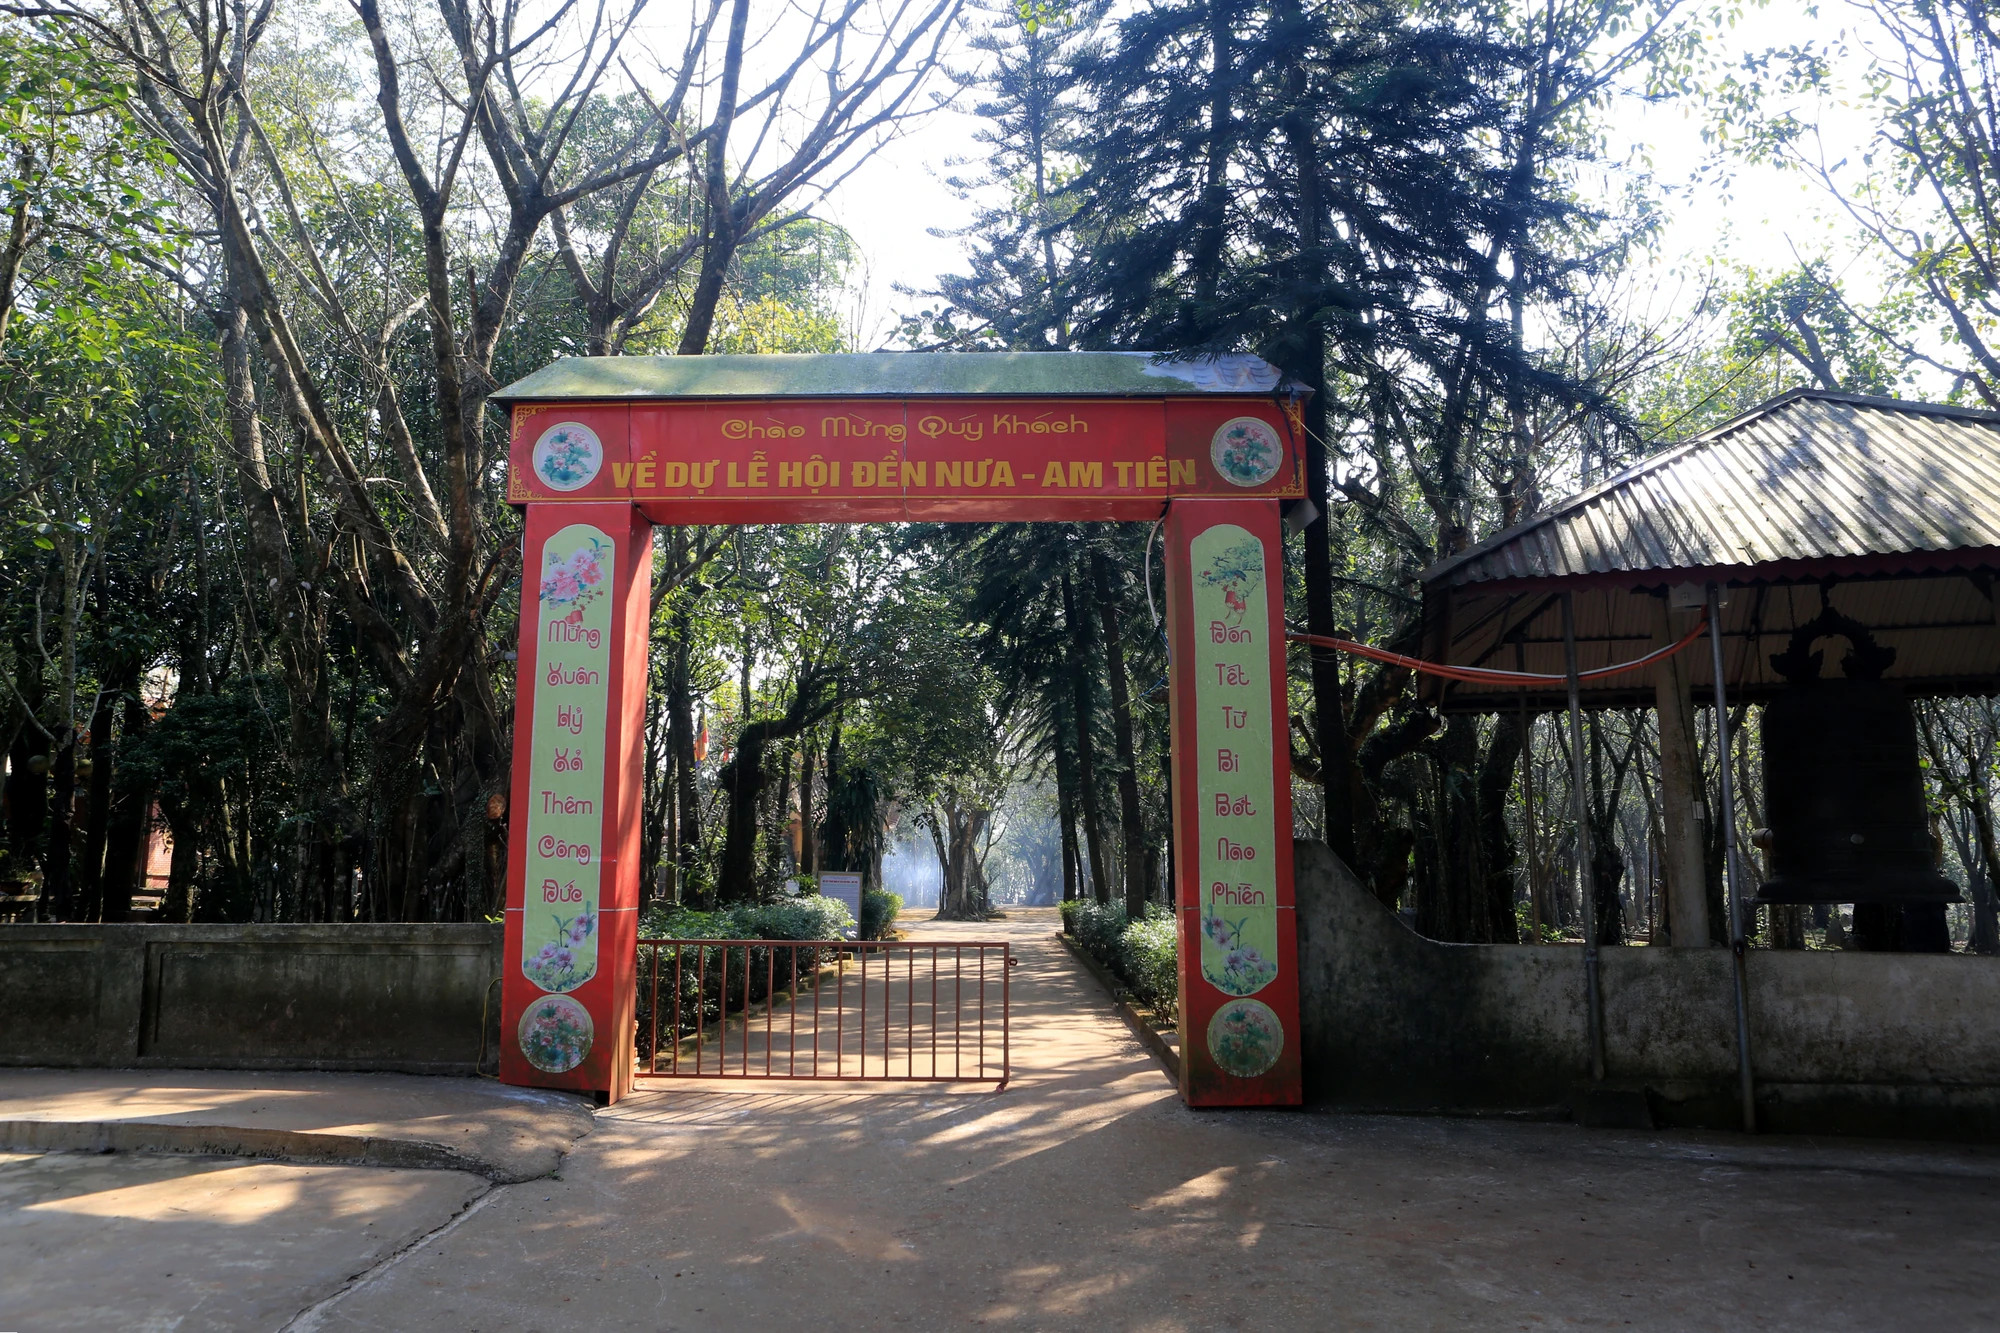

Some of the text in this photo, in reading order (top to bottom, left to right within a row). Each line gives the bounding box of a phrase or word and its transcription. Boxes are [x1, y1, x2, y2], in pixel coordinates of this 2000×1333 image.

[611, 450, 658, 488] VỀ
[664, 459, 720, 495] DỰ
[727, 450, 769, 488] LỄ
[778, 454, 840, 494] HỘI
[850, 450, 927, 488] ĐỀN
[936, 458, 1016, 488] NƯA
[1041, 461, 1103, 488] AM
[721, 412, 1088, 442] Chào Mừng Quý Khách
[538, 620, 601, 903] Mừng Xuân Hỷ Xả Thêm Công Đức
[1209, 620, 1265, 905] Đón Tết Từ Bi Bớt Não Phiền
